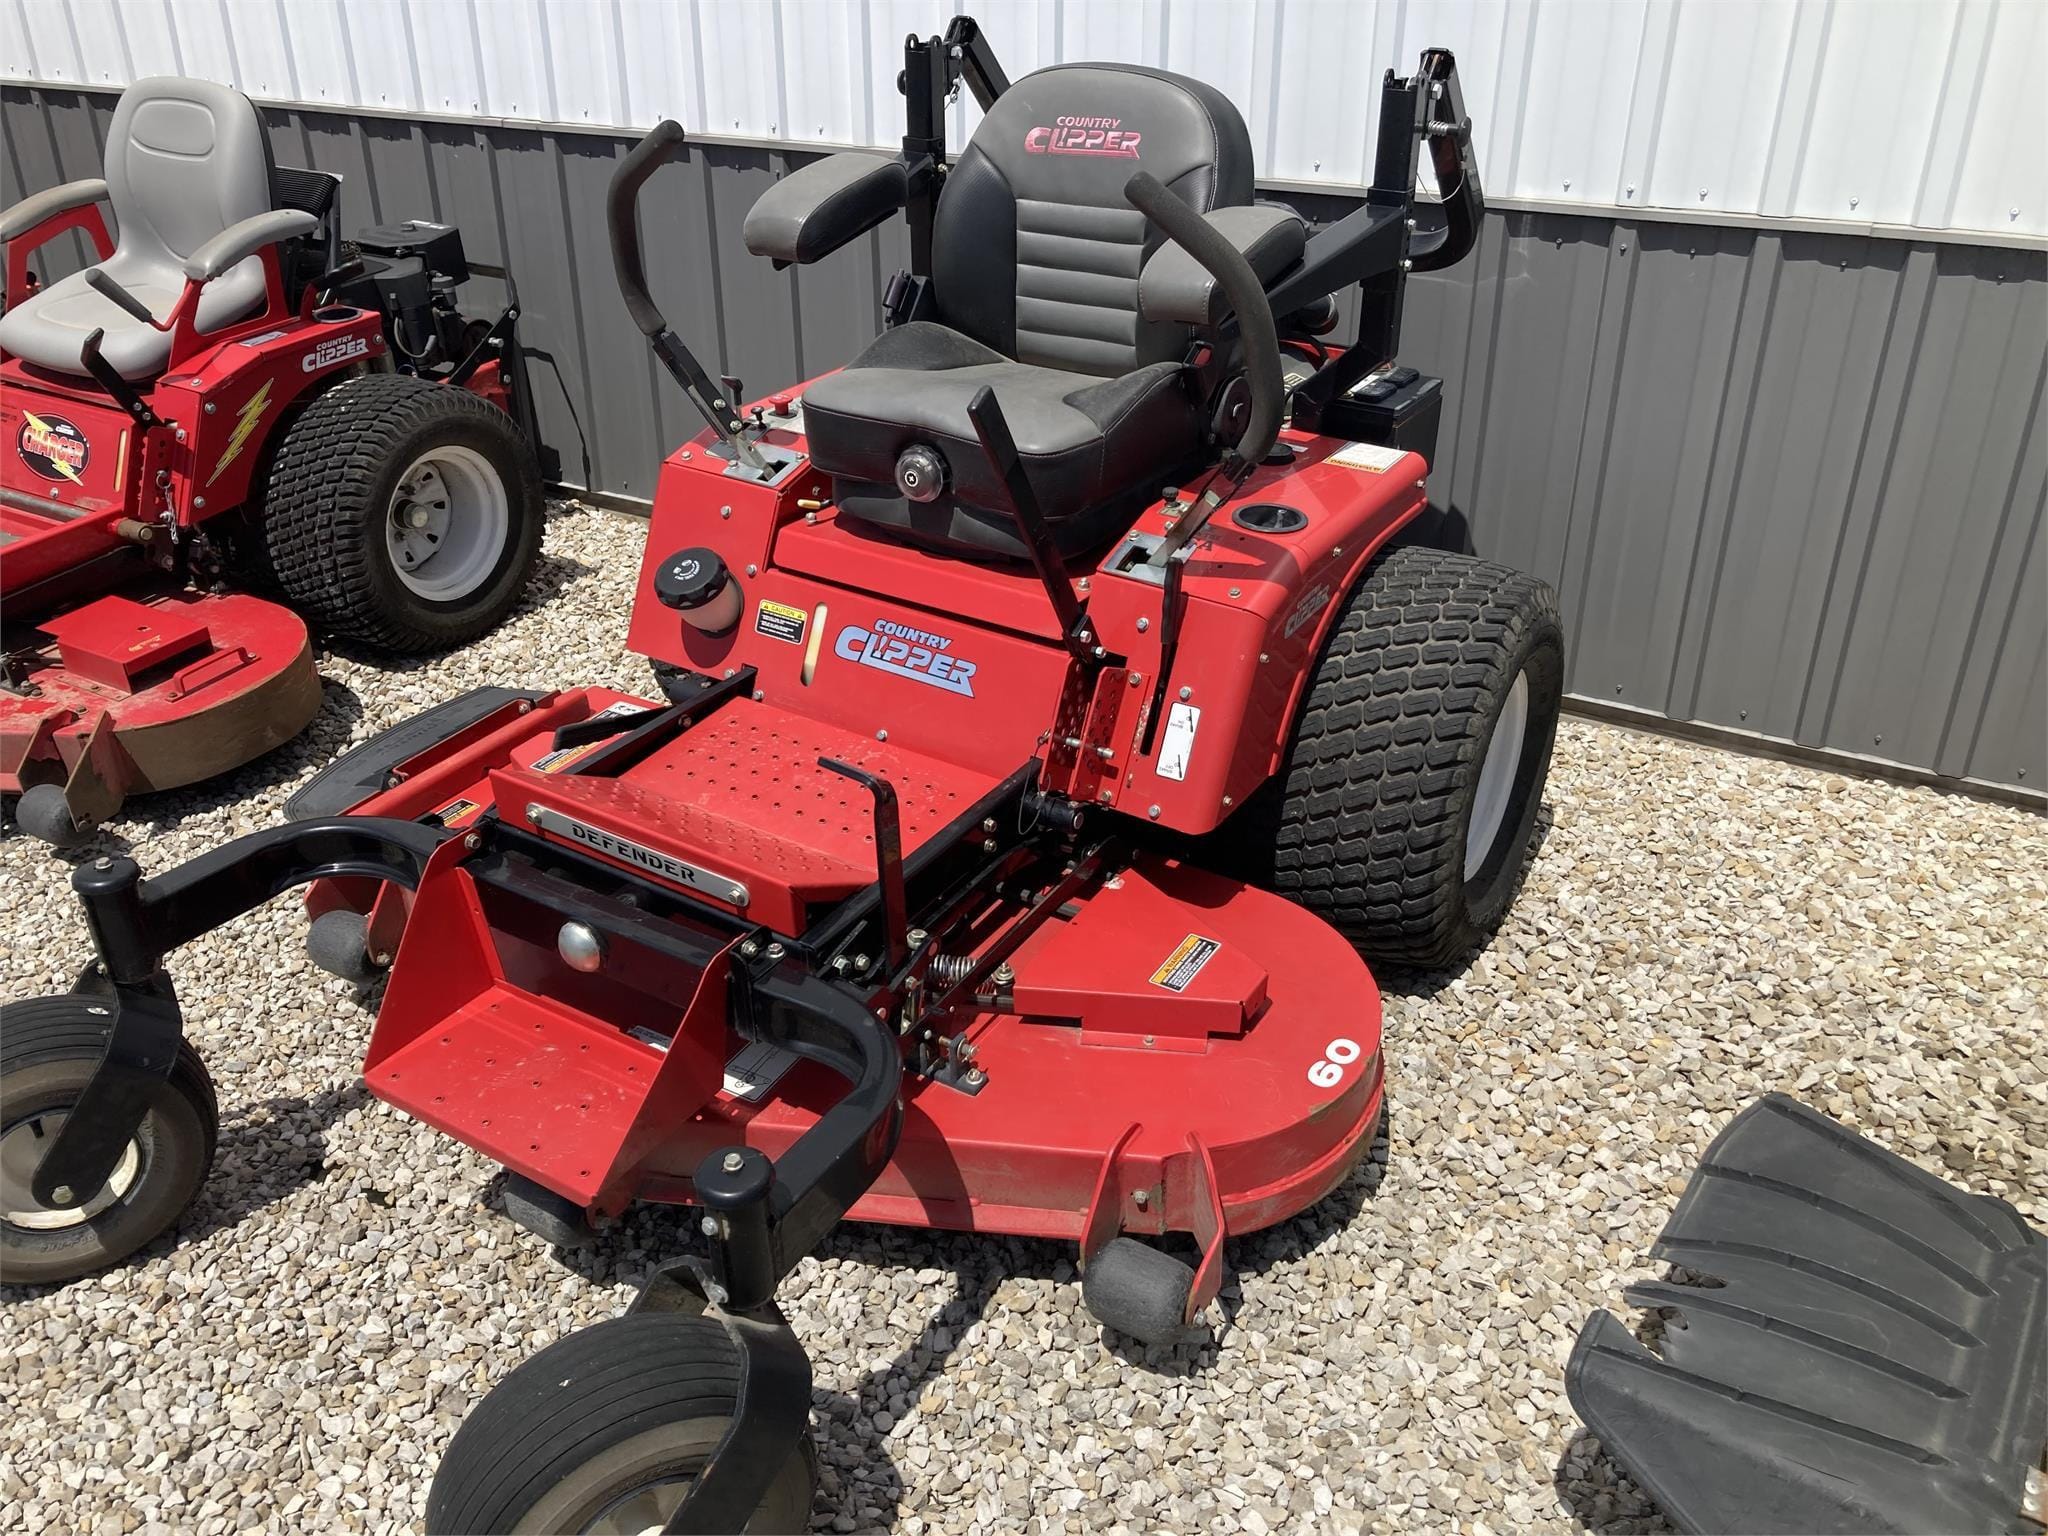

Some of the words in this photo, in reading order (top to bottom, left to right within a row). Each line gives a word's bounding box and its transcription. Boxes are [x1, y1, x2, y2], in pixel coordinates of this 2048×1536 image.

[1056, 116, 1121, 128] COUNTRY
[1024, 126, 1141, 160] CLIPPER
[302, 338, 369, 373] CLIPPER
[316, 334, 353, 351] COUNTRY
[22, 425, 84, 468] CHARGER
[770, 604, 796, 617] CAUTION
[873, 618, 953, 650] COUNTRY
[834, 625, 977, 698] CLIPPER
[571, 823, 696, 884] DEFENDER
[1307, 1038, 1361, 1088] 60
